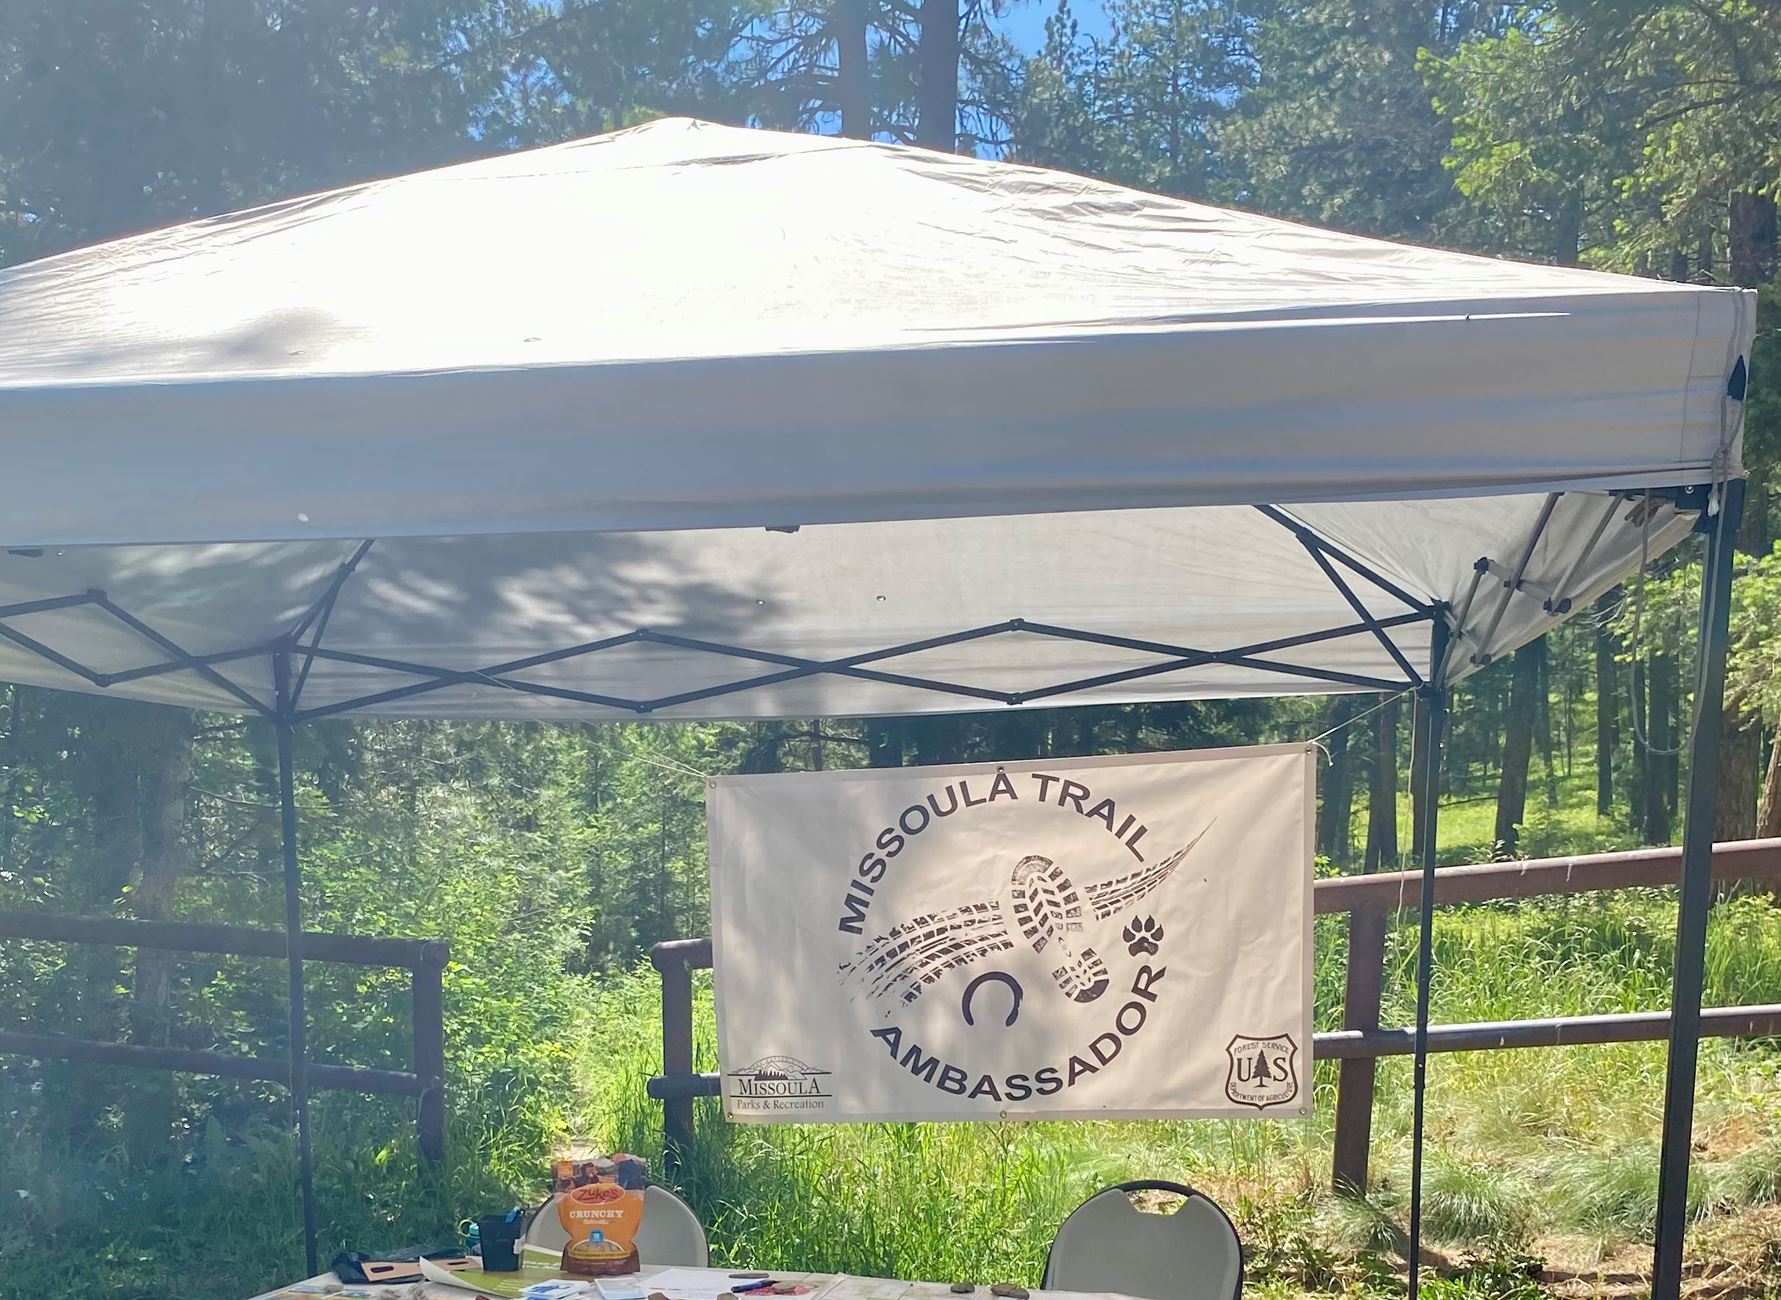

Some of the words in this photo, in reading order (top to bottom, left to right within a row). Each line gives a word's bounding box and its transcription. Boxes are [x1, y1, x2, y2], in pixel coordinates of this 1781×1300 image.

[839, 773, 1018, 935] MISSOULA
[1032, 772, 1148, 863] TRAIL
[870, 965, 1167, 1102] AMBASSADOR
[1233, 1041, 1259, 1056] FOREST
[1262, 1041, 1290, 1056] SERVICE
[737, 1099, 761, 1110] Parks
[762, 1100, 770, 1109] &
[773, 1099, 825, 1109] Recreation
[569, 1209, 625, 1219] CRUNCHY
